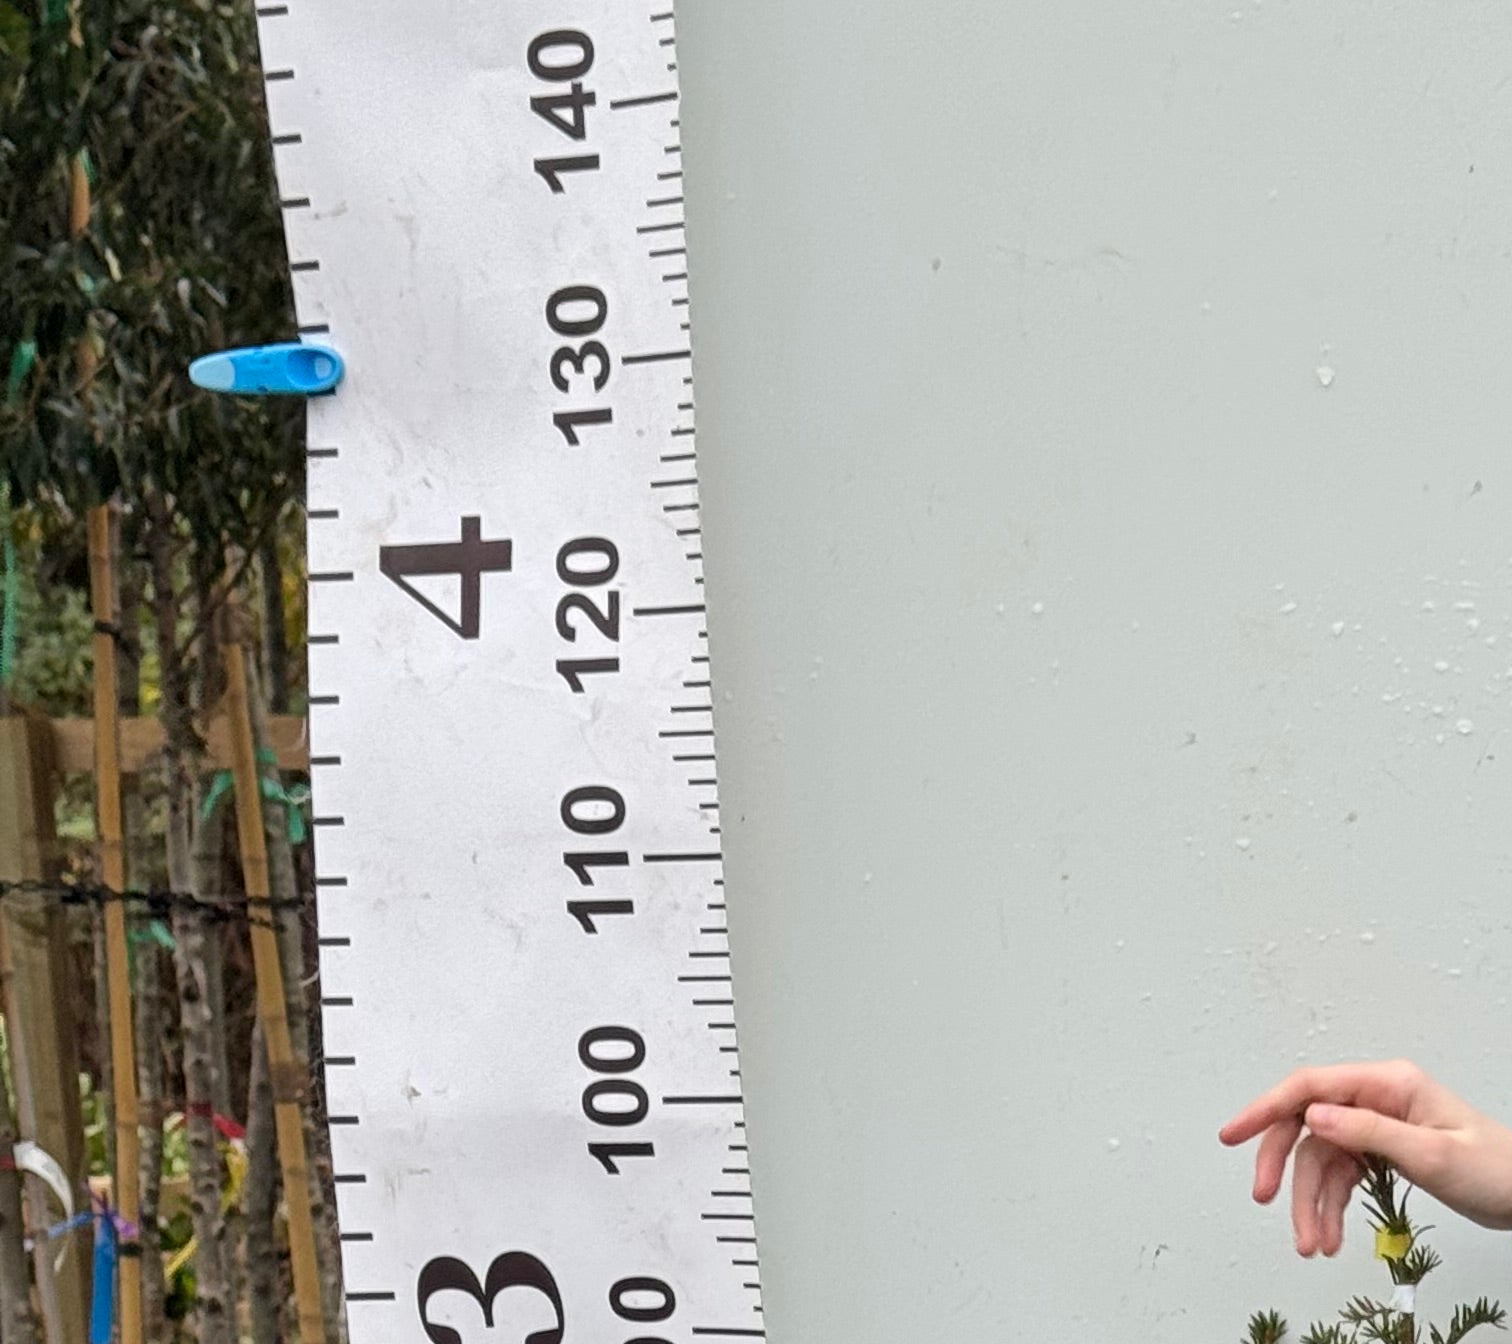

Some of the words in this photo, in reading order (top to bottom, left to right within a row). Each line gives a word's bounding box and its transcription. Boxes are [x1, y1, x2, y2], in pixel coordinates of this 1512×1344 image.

[527, 29, 600, 194] 140
[545, 285, 613, 446] 130
[379, 516, 512, 639] 4
[555, 537, 620, 693] 120
[560, 785, 634, 934] 110
[578, 1025, 655, 1175] 100
